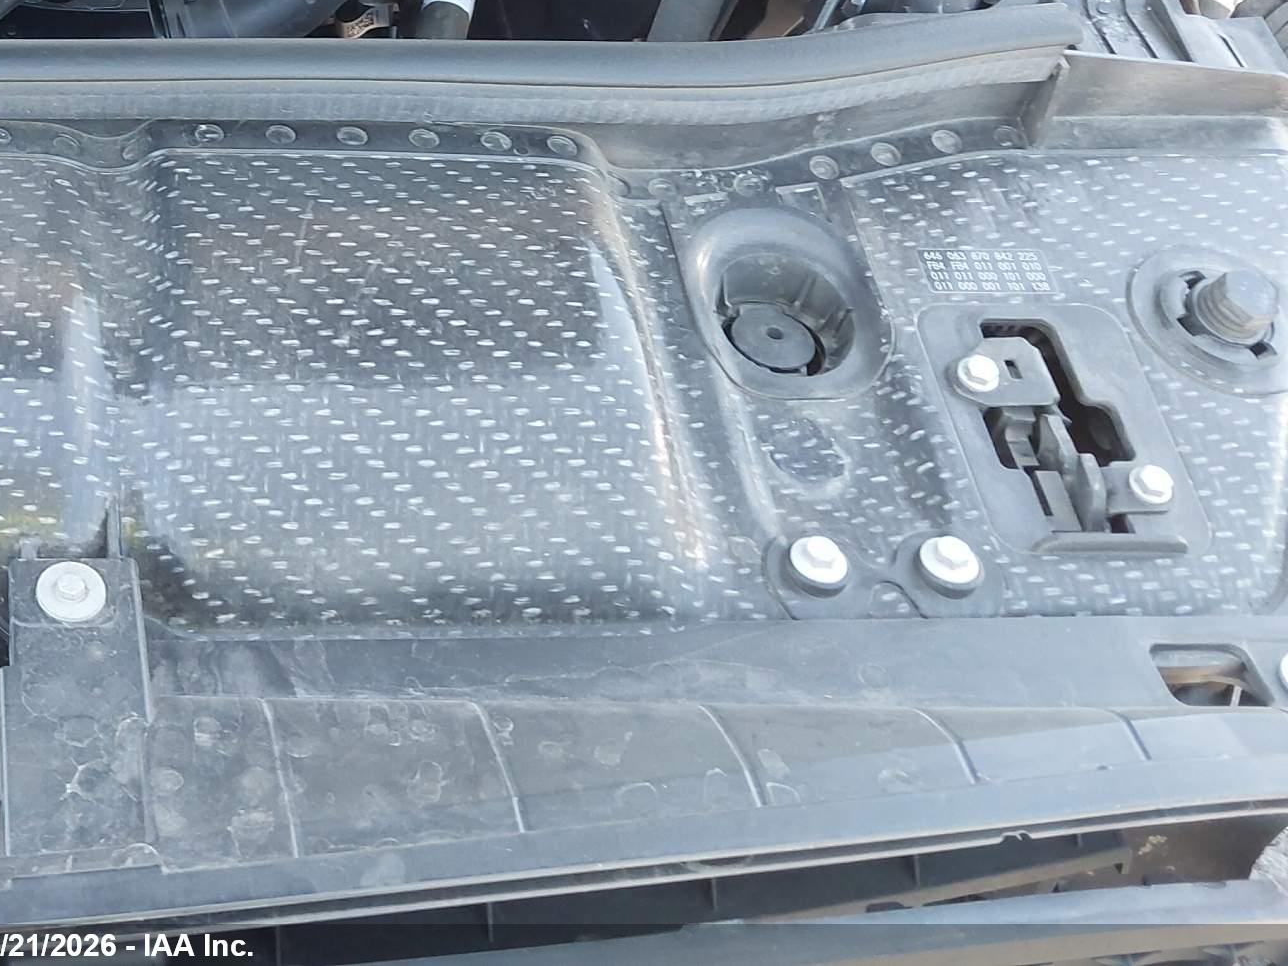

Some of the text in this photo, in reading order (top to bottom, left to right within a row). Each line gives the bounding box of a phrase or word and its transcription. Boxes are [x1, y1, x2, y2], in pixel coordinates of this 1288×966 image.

[974, 261, 993, 271] 011
[1021, 261, 1042, 271] 010
[930, 271, 950, 280] 011
[953, 271, 974, 280] 011
[1002, 272, 1022, 281] 101
[934, 281, 954, 291] 011
